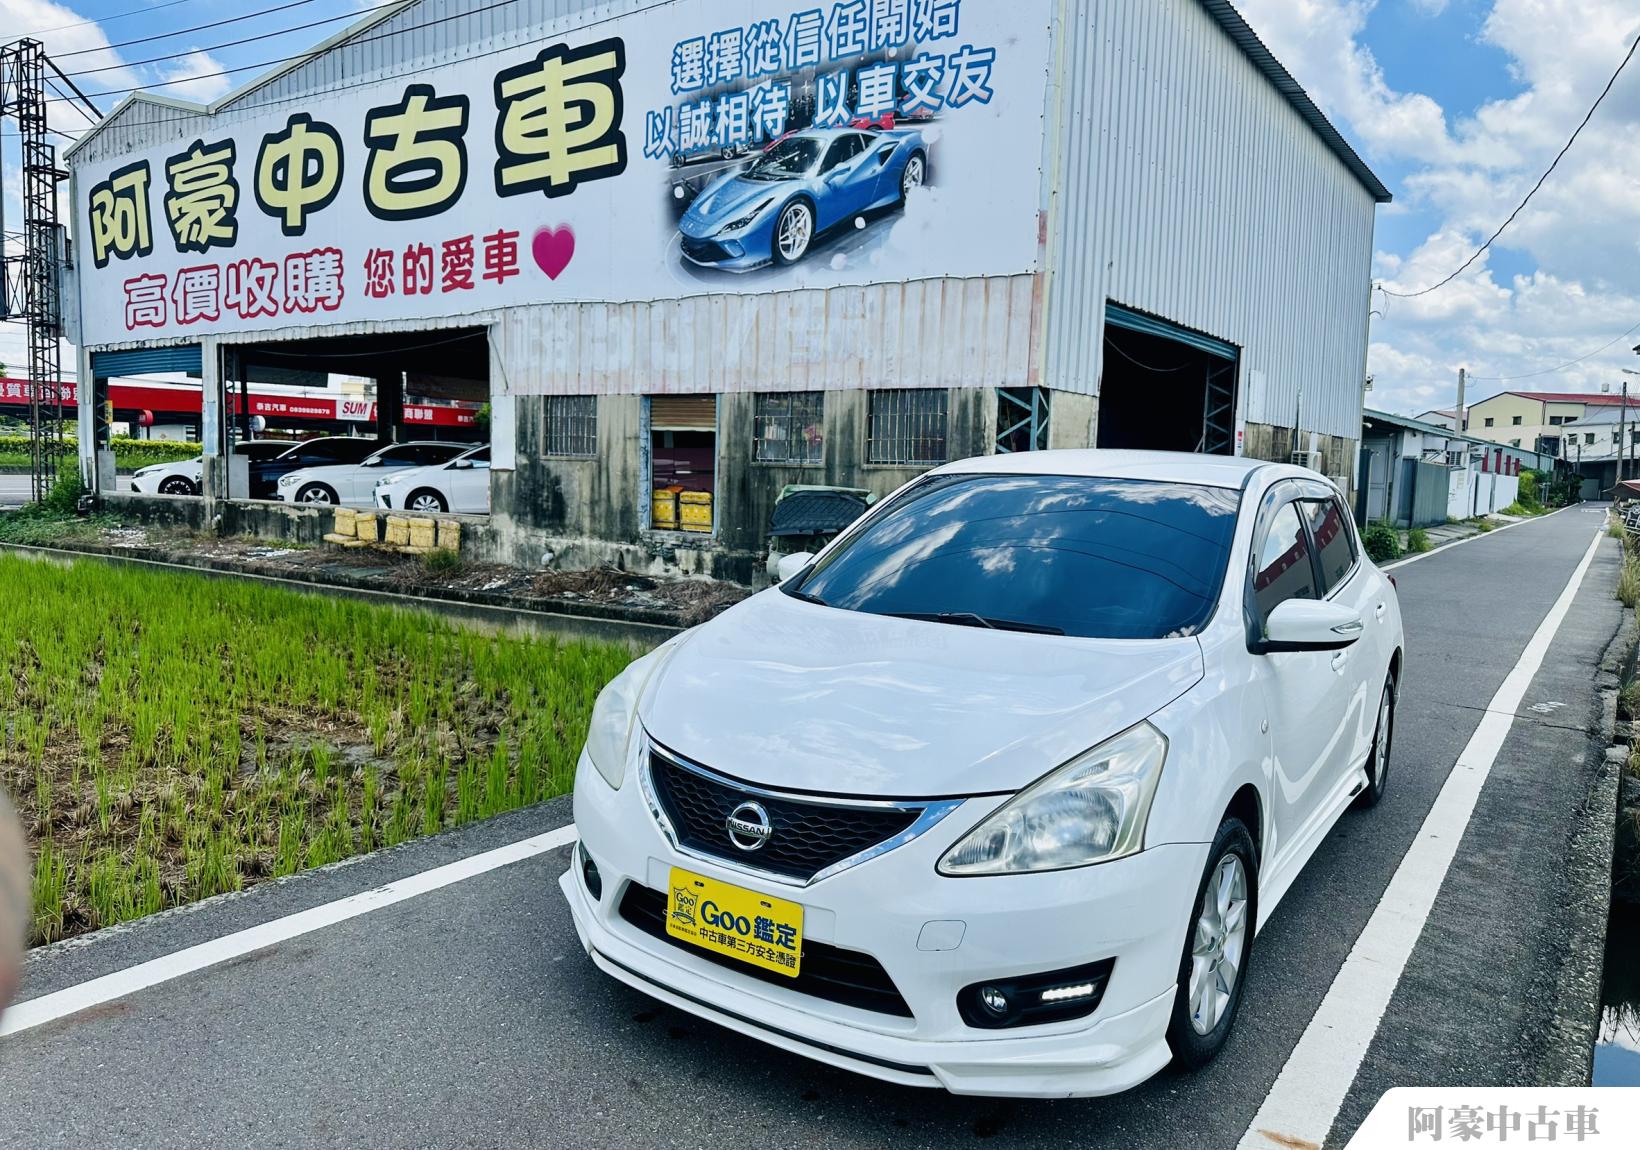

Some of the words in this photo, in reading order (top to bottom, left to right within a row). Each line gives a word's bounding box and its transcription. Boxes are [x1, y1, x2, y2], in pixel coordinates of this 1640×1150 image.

[671, 0, 961, 96] 選擇從信任開始
[643, 79, 791, 159] 以誠相待
[812, 45, 997, 130] 以車交友
[89, 36, 628, 268] 阿豪中古車
[124, 246, 344, 331] 高價收購
[363, 228, 521, 299] 您的愛車
[342, 401, 368, 415] SUM
[729, 818, 766, 836] NISSAN
[699, 927, 797, 969] 中古車第三方安全憑證
[700, 900, 751, 936] Goo
[753, 915, 797, 951] 鑑定
